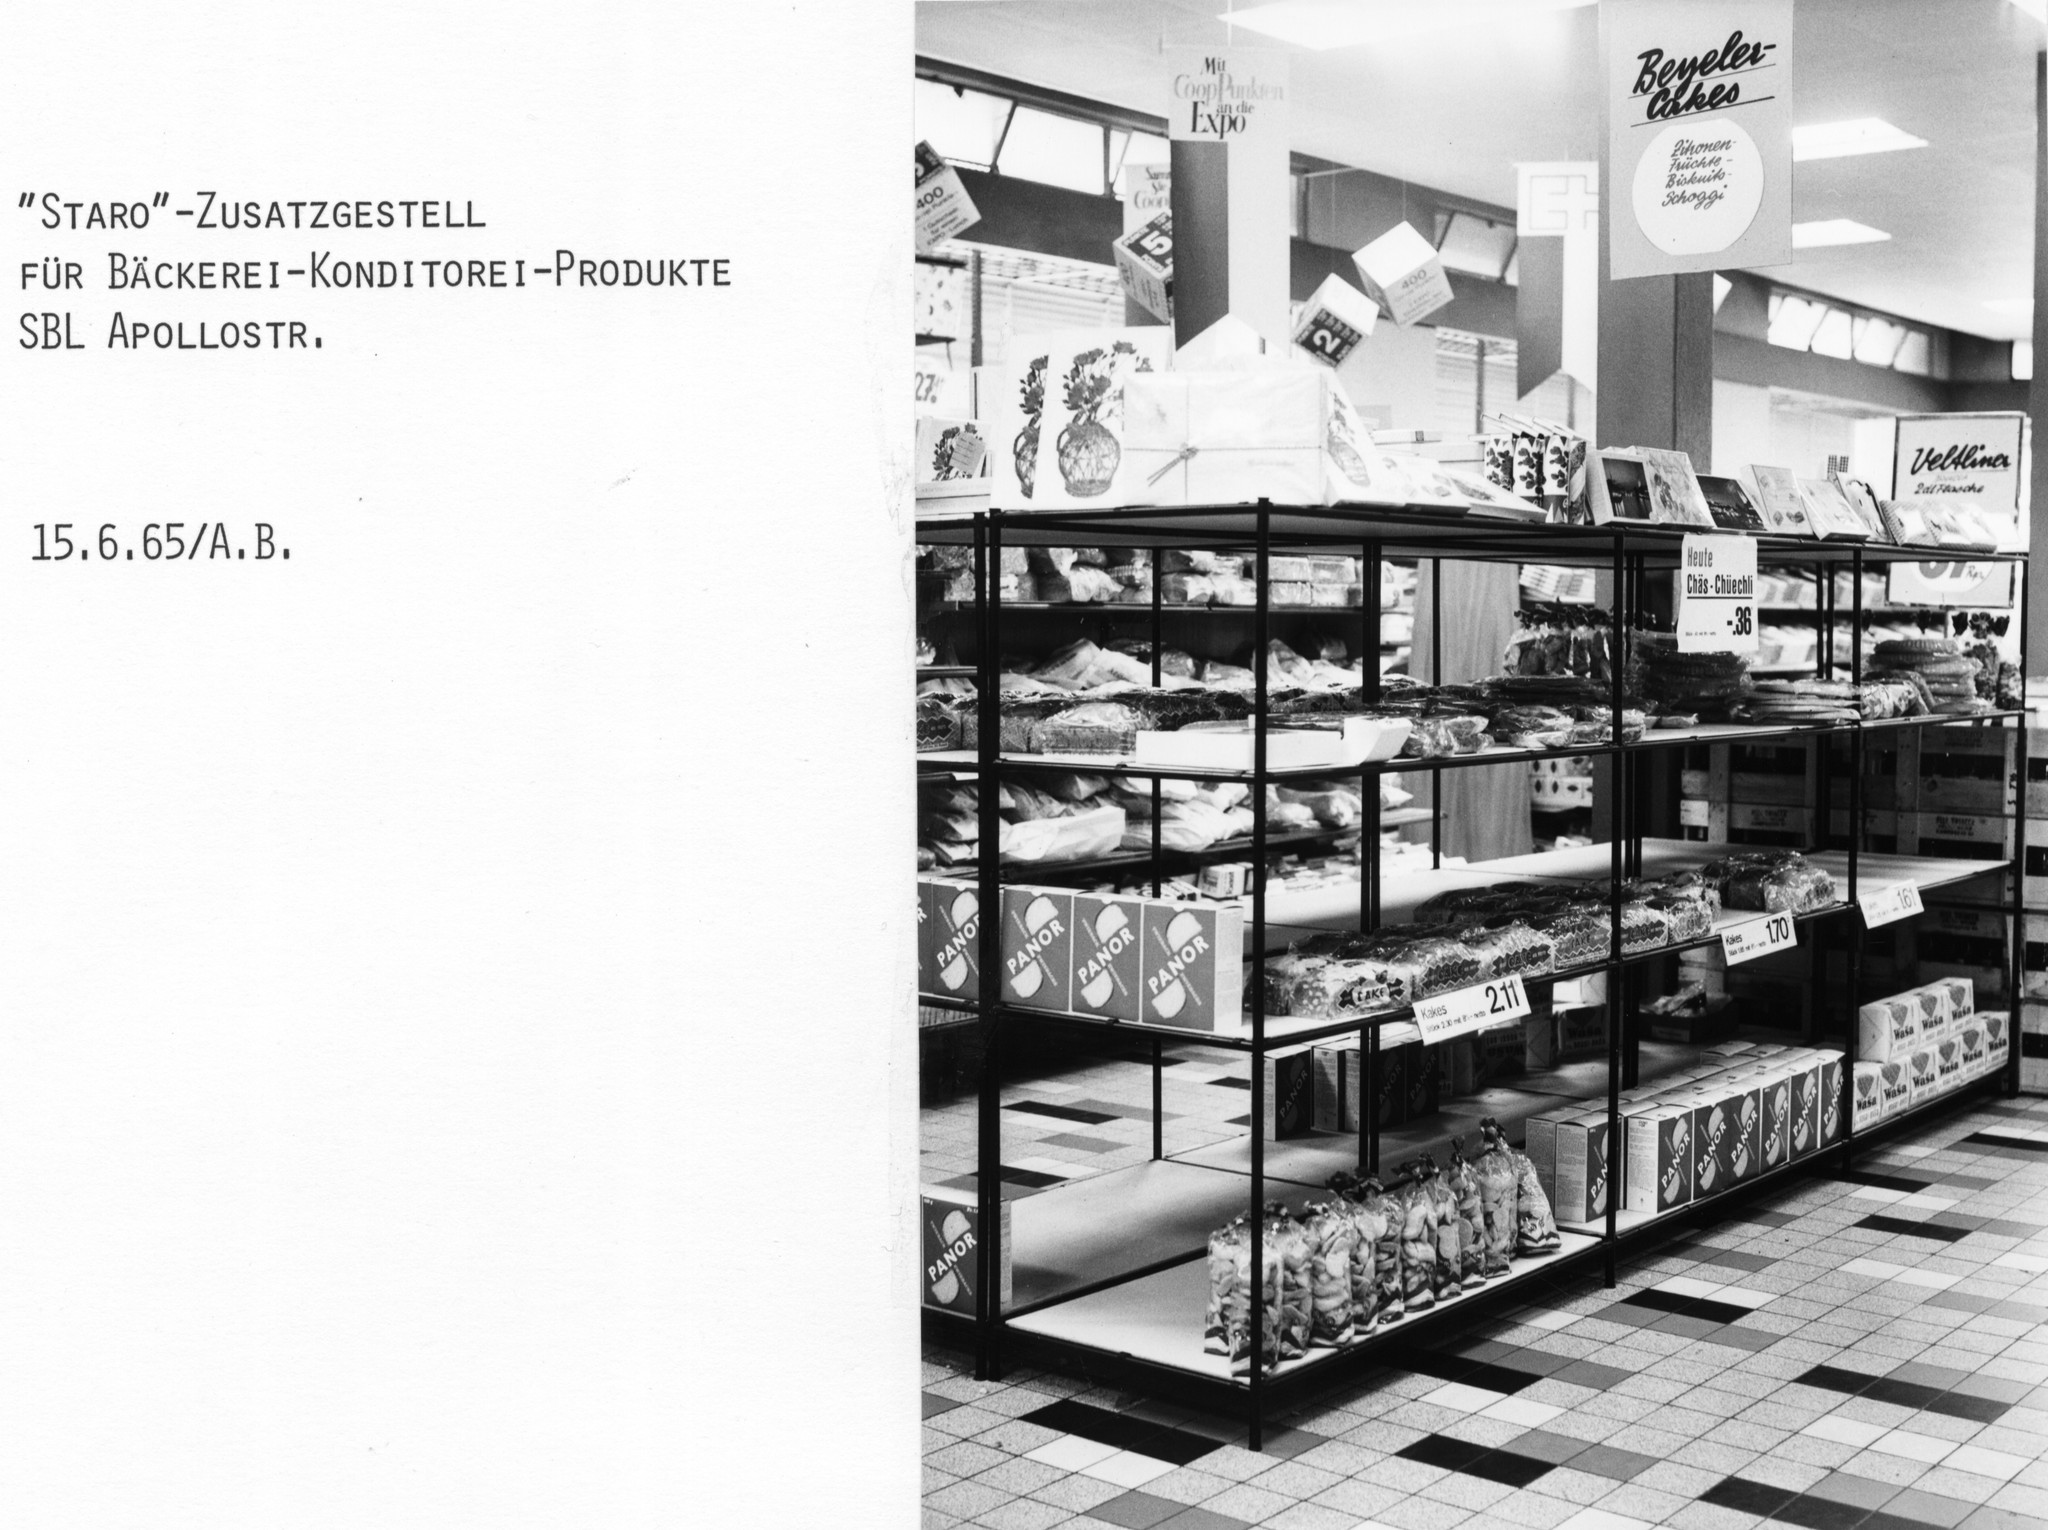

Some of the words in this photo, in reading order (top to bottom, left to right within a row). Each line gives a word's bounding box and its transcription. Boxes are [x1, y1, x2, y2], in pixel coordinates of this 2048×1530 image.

[1200, 56, 1226, 75] Mit
[1191, 100, 1247, 140] Expo
[1216, 103, 1233, 115] an
[1235, 100, 1255, 114] die
[1646, 82, 1740, 120] Cakes
[1661, 184, 1728, 211] Schoggi
[1139, 229, 1174, 256] 5
[1312, 328, 1342, 355] 2
[1687, 546, 1713, 568] Heute
[1006, 919, 1065, 975] PANOR
[1724, 934, 1743, 946] Kakes
[1765, 916, 1789, 944] 1.70
[1077, 927, 1135, 985] PANOR
[1147, 935, 1210, 995] PANOR
[1420, 1005, 1448, 1020] Kakes
[1485, 979, 1520, 1015] 2.11
[1279, 1069, 1308, 1118] PANOR
[1379, 1065, 1402, 1105] ANOR
[1823, 1075, 1845, 1125] PANOR
[1764, 1100, 1789, 1152] PANOR
[1792, 1086, 1818, 1137] PANOR
[1697, 1121, 1727, 1175] PANOR
[1730, 1110, 1758, 1163] PANOR
[1590, 1162, 1608, 1198] PAN
[1661, 1132, 1691, 1188] PANOR
[928, 1232, 978, 1282] PANOR
